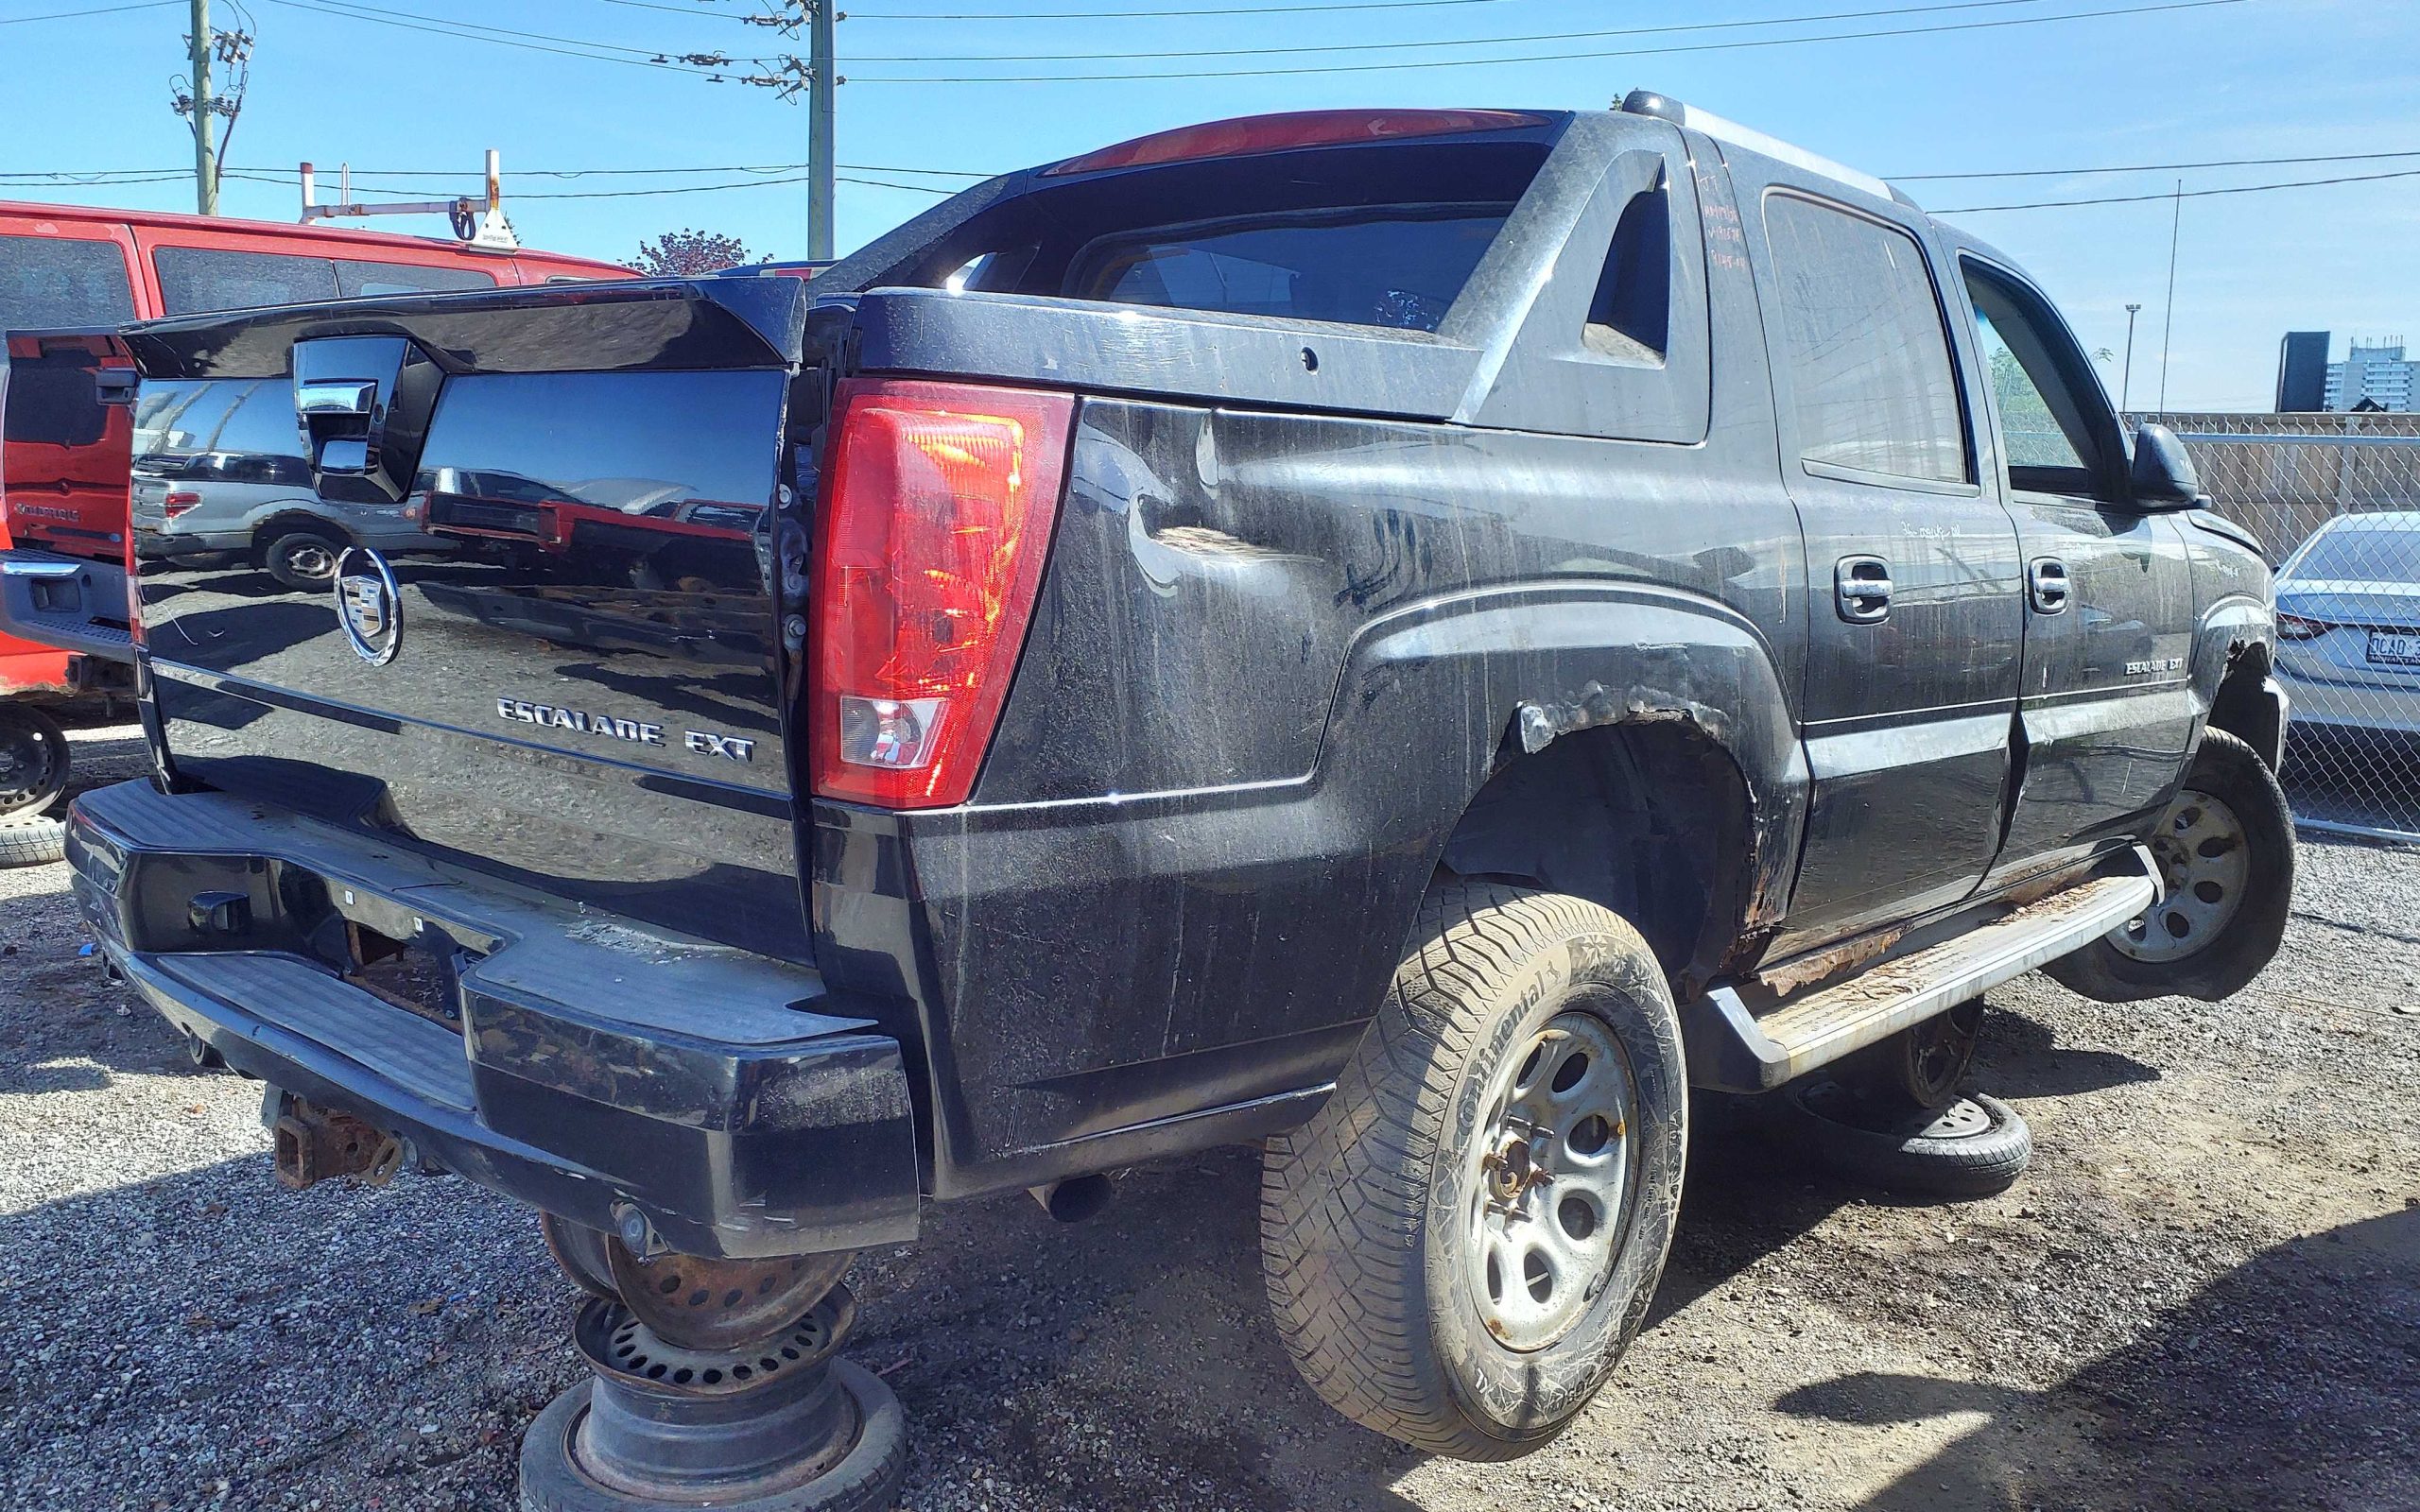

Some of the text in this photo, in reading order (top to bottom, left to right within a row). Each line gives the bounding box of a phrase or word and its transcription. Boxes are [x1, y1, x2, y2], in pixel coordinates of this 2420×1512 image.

[2125, 657, 2184, 675] ESCALADE EXT
[497, 697, 757, 764] ESCALADE EXT
